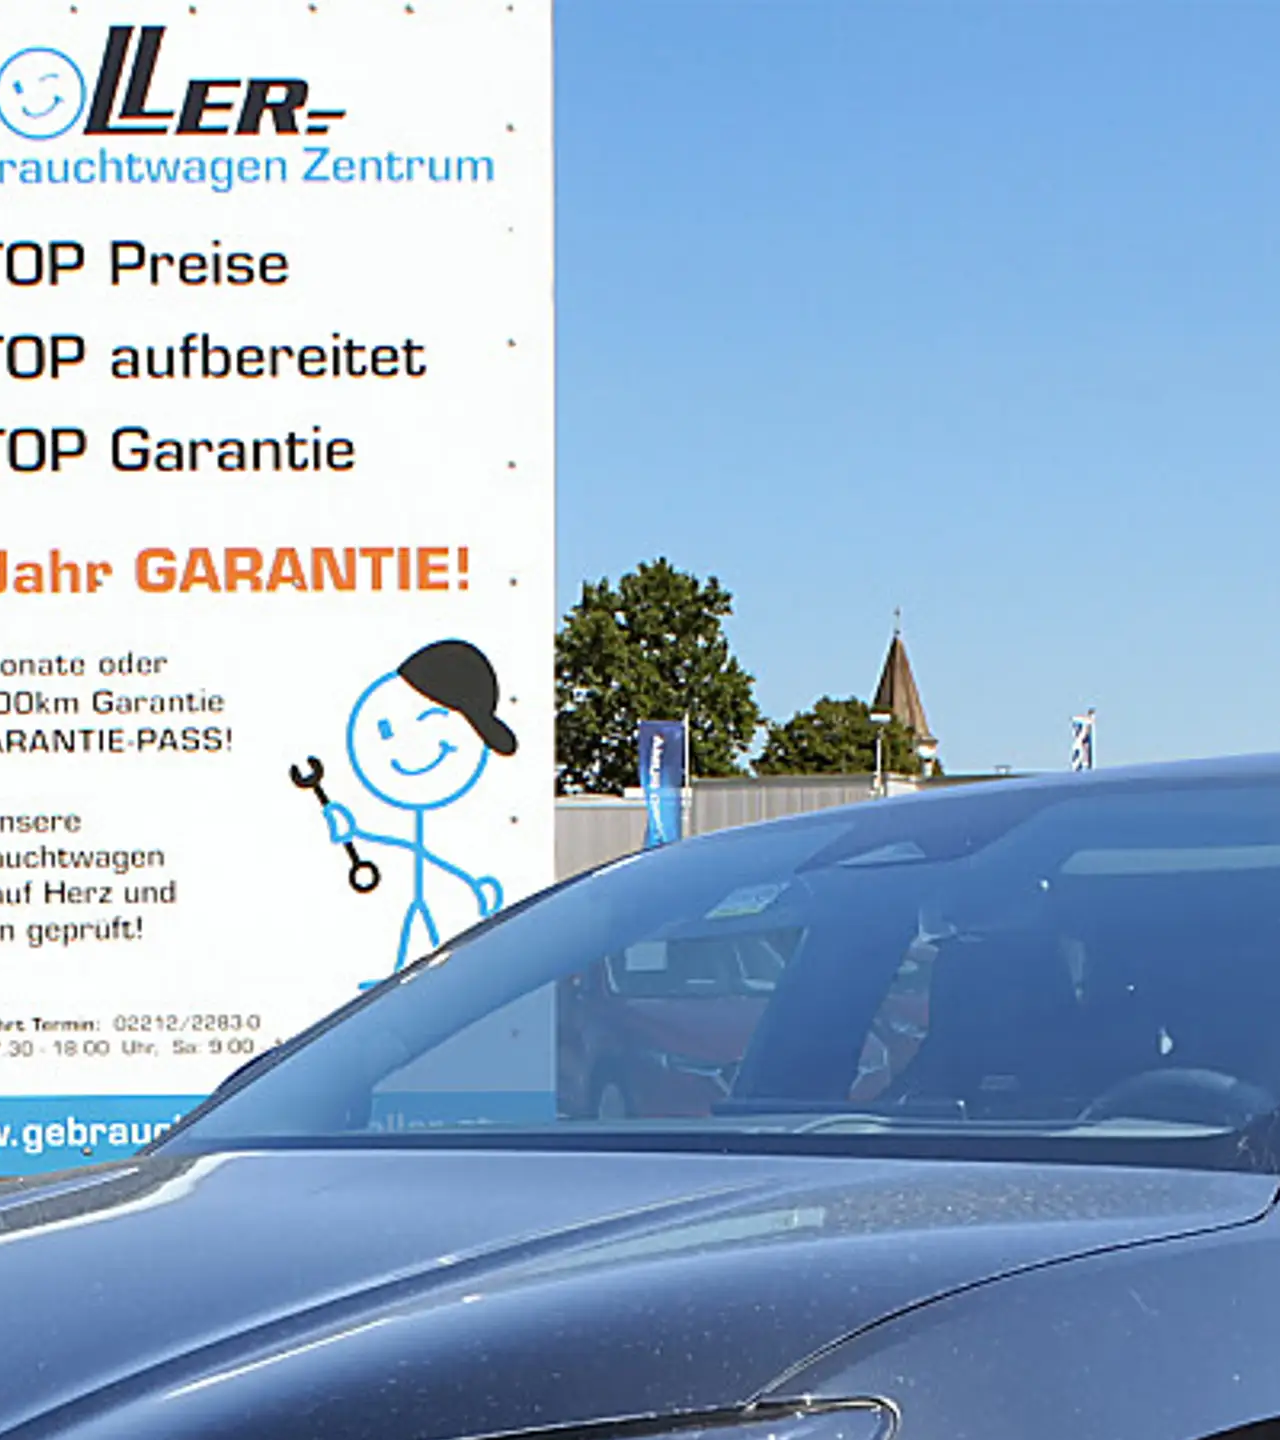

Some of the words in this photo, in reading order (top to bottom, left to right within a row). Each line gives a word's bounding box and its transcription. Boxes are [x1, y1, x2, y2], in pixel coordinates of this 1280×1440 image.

[302, 146, 494, 182] Zentrum
[110, 239, 289, 286] Preise
[111, 332, 427, 379] aufbereitet
[112, 425, 355, 472] Garantie
[136, 546, 469, 593] GARANTIE!
[98, 652, 169, 677] oder
[92, 688, 225, 716] Garantie
[44, 881, 113, 905] Herz
[124, 880, 177, 904] und
[26, 916, 143, 949] geprüft!
